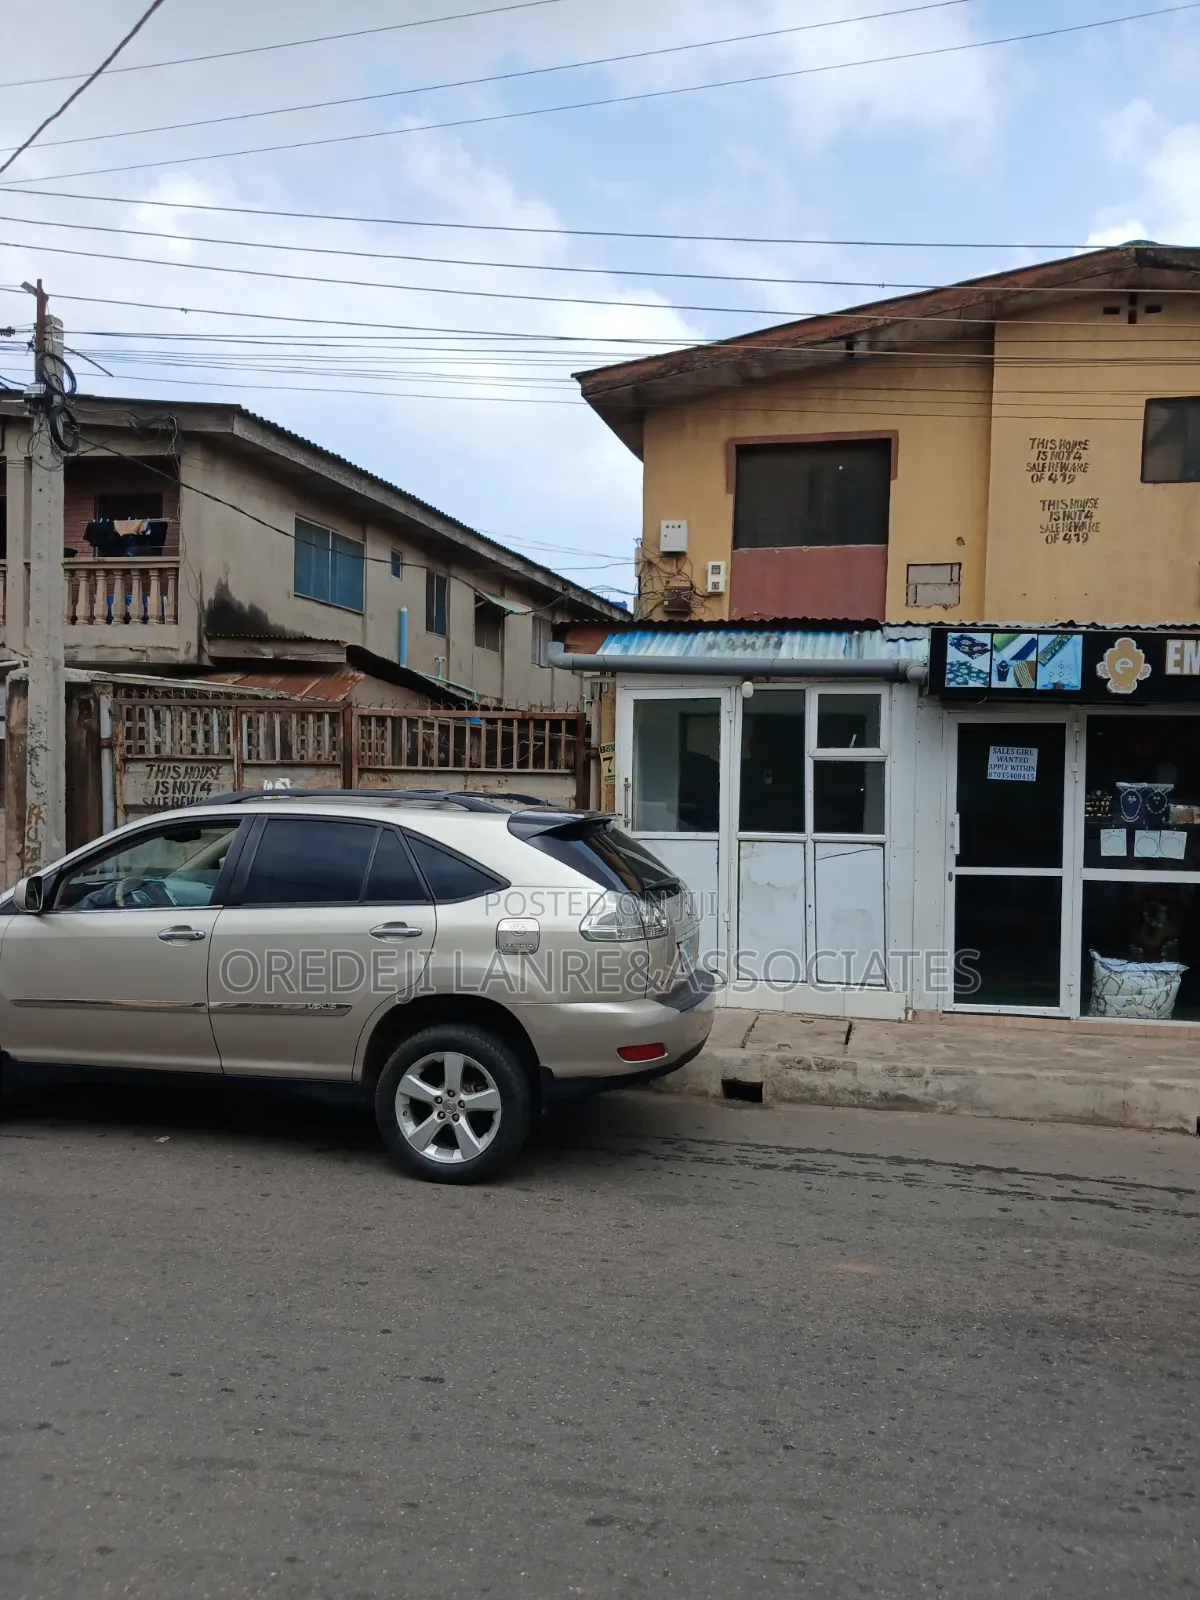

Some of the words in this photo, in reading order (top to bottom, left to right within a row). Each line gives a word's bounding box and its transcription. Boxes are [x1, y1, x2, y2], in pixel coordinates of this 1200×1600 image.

[1029, 437, 1057, 450] THIS
[1058, 438, 1091, 451] HOUSE
[1036, 450, 1048, 461] IS
[1050, 450, 1073, 461] NOT
[1072, 451, 1083, 461] 4
[1026, 462, 1047, 472] SALE
[1047, 461, 1091, 473] BEWARE
[1030, 473, 1045, 483] OF
[1048, 472, 1076, 485] 419
[1039, 499, 1068, 511] THIS
[1069, 498, 1100, 509] HOUSE
[1049, 511, 1060, 522] IS
[1062, 509, 1085, 521] NOT
[1083, 510, 1094, 521] 4
[1039, 523, 1060, 533] SALE
[1061, 521, 1100, 533] BEWARE
[1045, 533, 1059, 544] OF
[1062, 532, 1089, 544] 419
[992, 747, 1015, 755] SALES
[1016, 748, 1034, 756] GIRL
[996, 755, 1029, 763] WANTED
[145, 764, 181, 780] THIS
[182, 763, 223, 781] HOUSE
[988, 763, 1009, 771] APPLY
[1010, 764, 1035, 772] WITHIN
[154, 780, 169, 795] IS
[171, 780, 201, 795] NOT
[200, 780, 212, 795] 4
